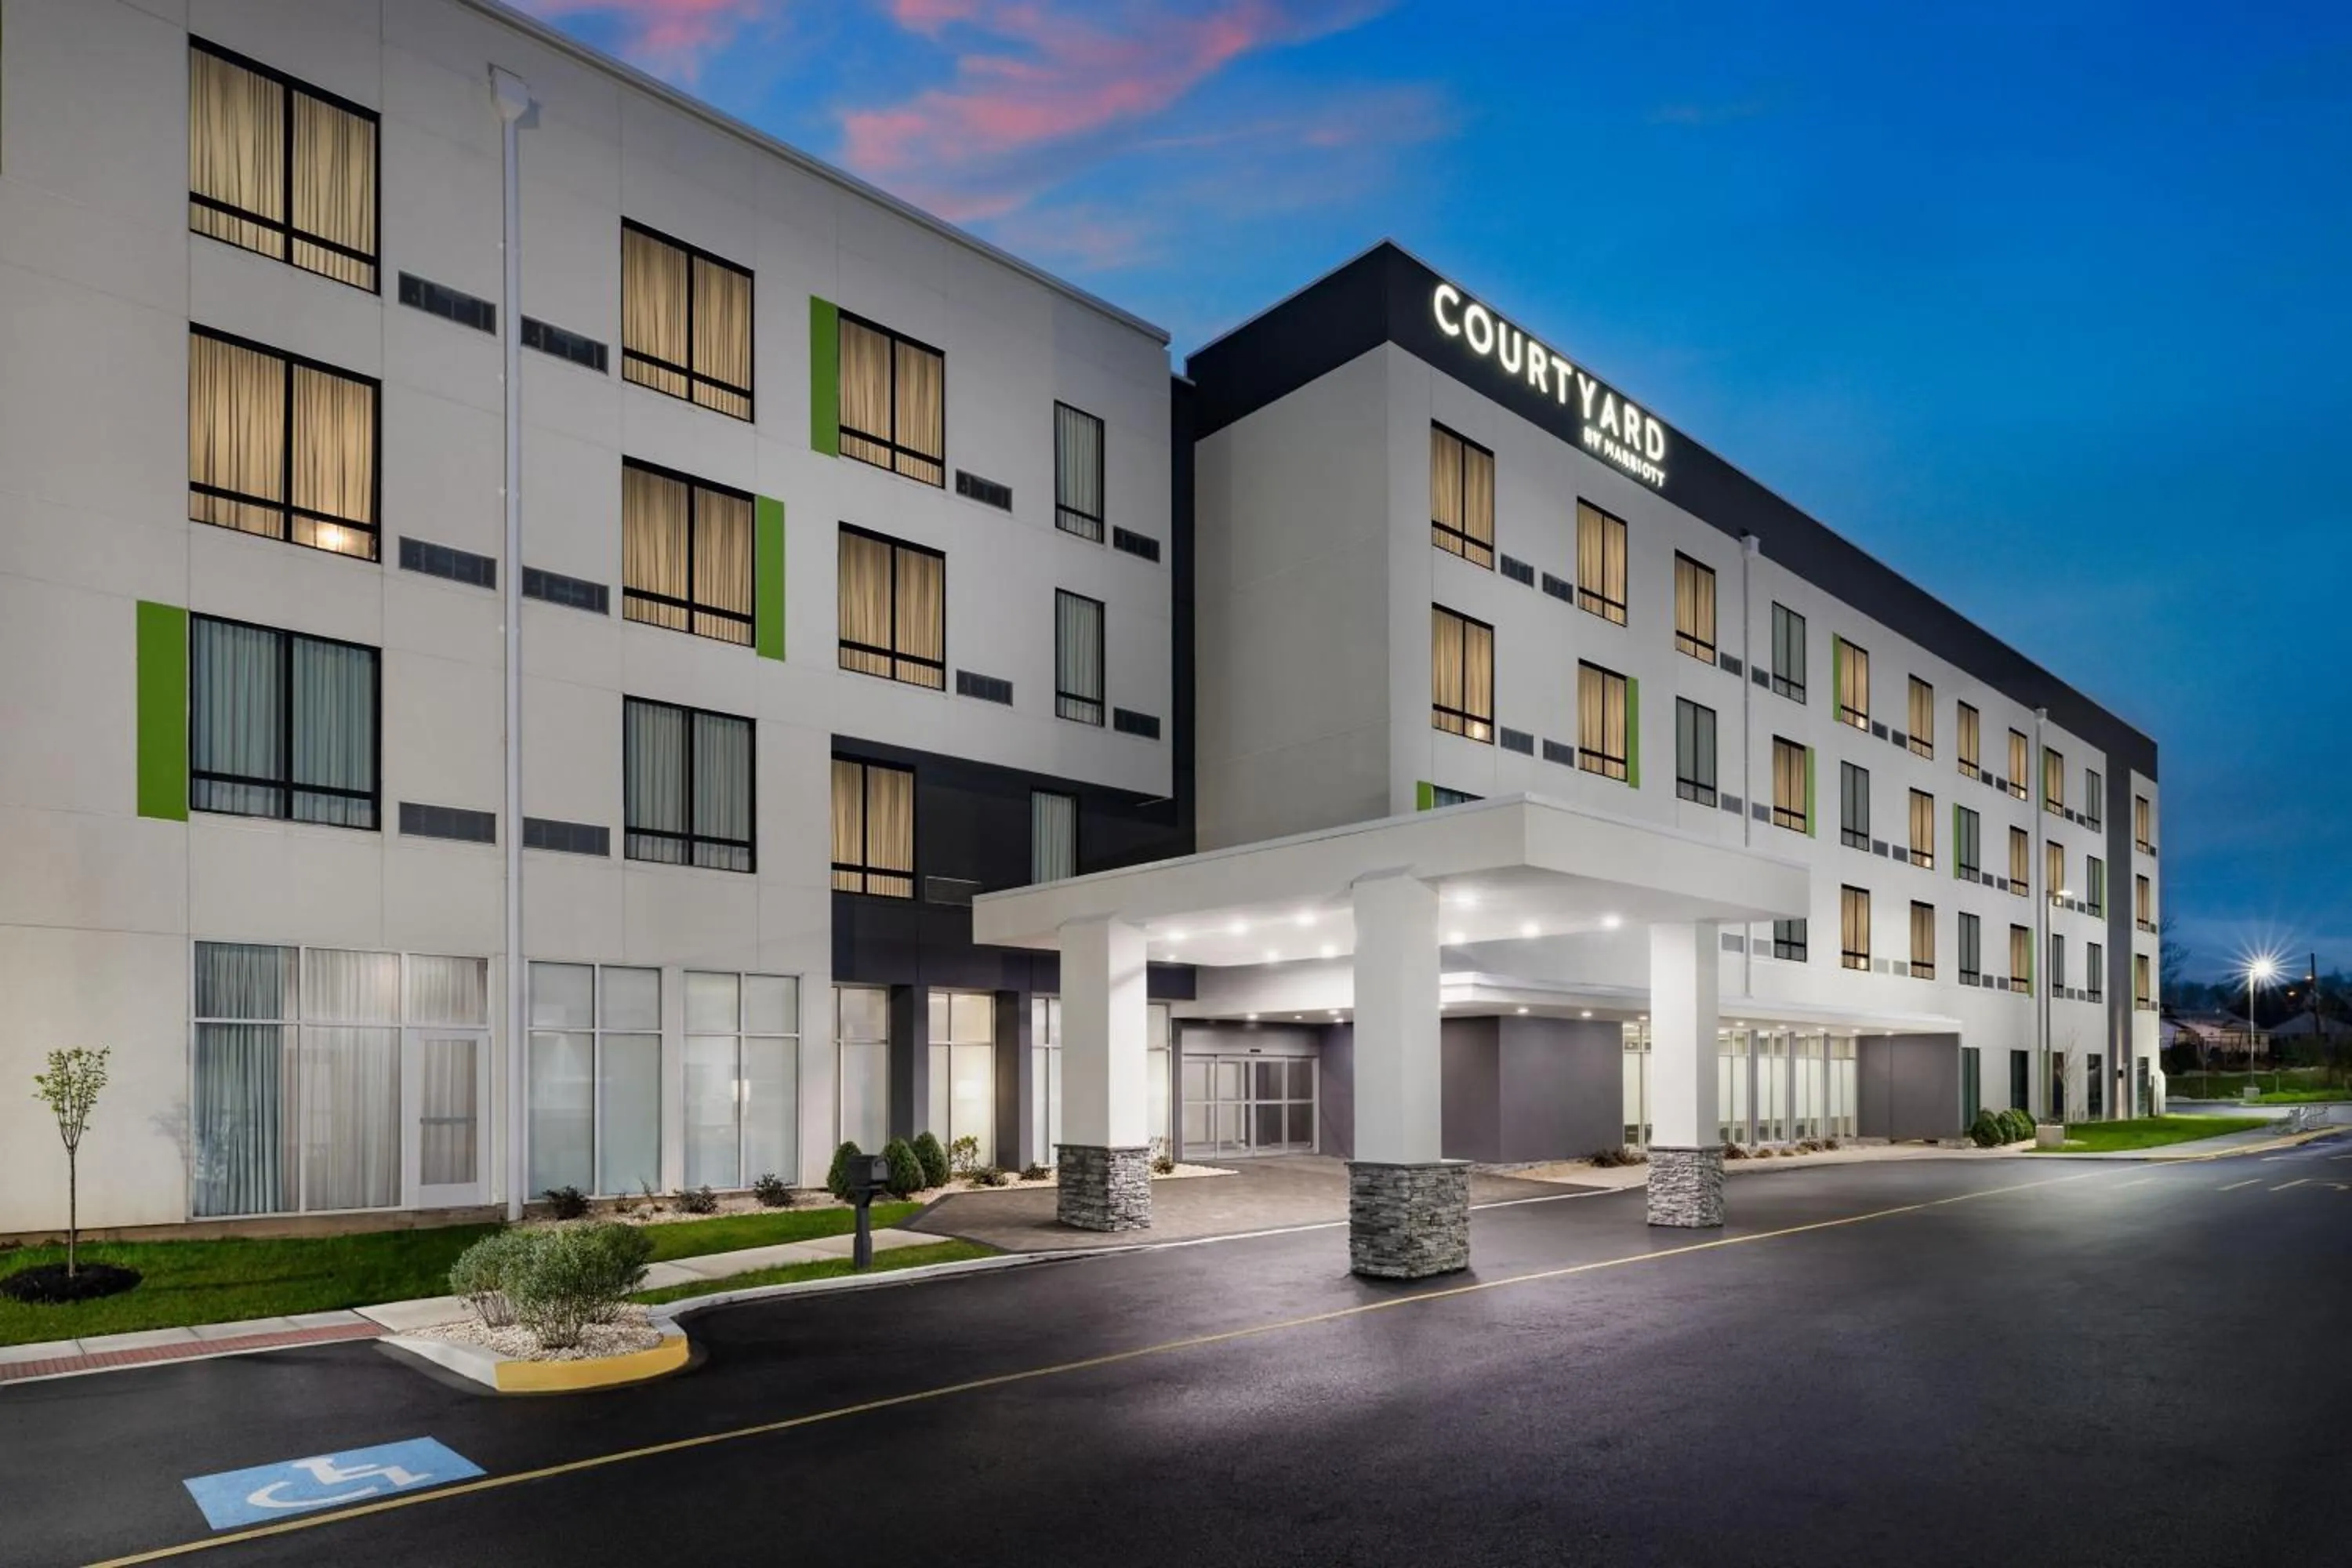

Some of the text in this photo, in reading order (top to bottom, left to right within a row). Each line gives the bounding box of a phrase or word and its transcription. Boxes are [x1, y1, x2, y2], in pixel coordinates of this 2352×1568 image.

[1433, 283, 1665, 463] COURTYARD
[1583, 426, 1666, 488] BY MARRIOTT
